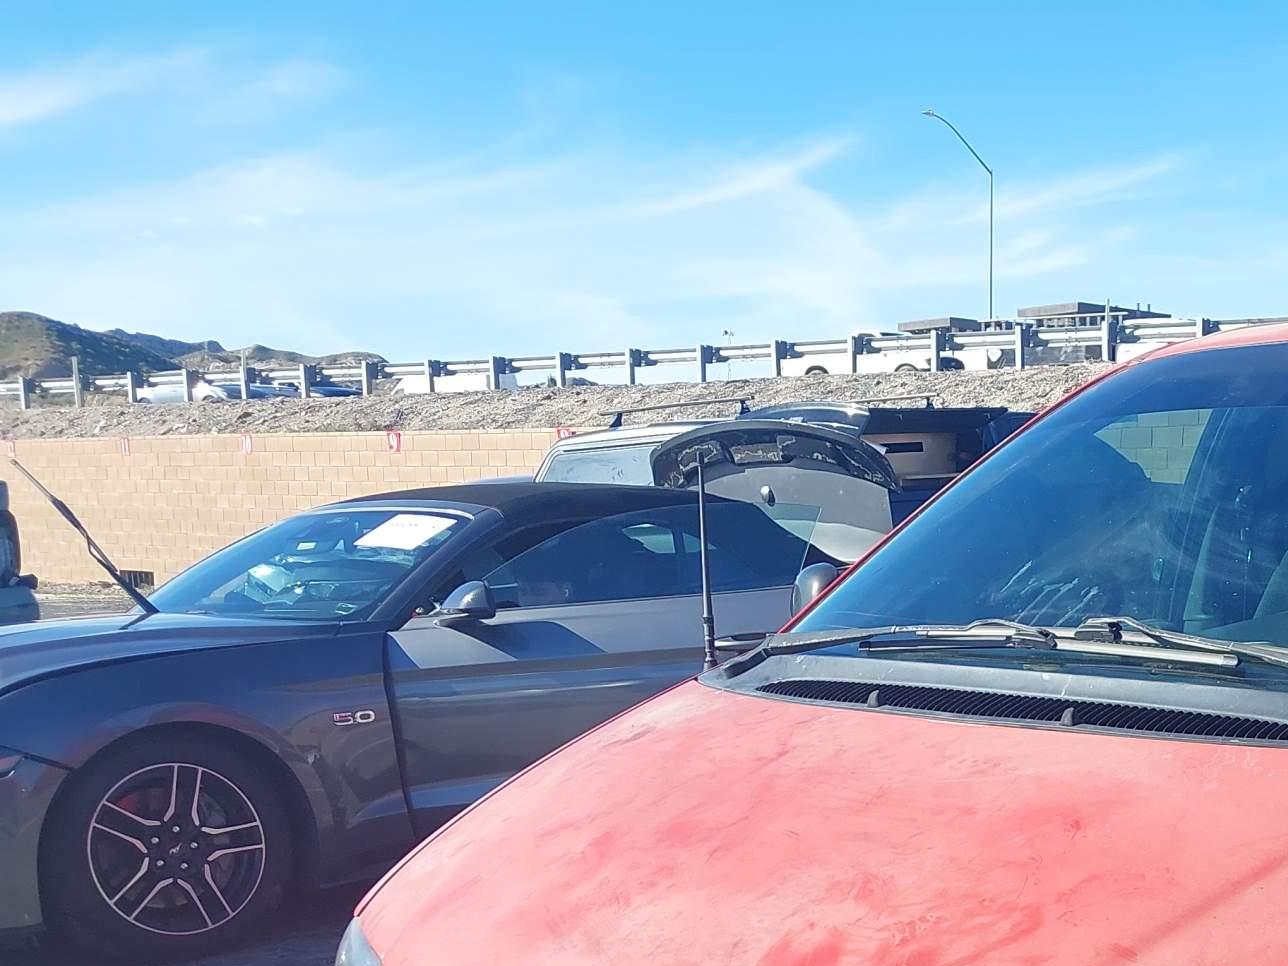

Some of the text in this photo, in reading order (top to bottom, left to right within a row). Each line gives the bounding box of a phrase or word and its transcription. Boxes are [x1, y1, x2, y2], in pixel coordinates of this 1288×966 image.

[120, 438, 129, 456] 11
[241, 434, 252, 455] 10
[388, 433, 398, 452] 9
